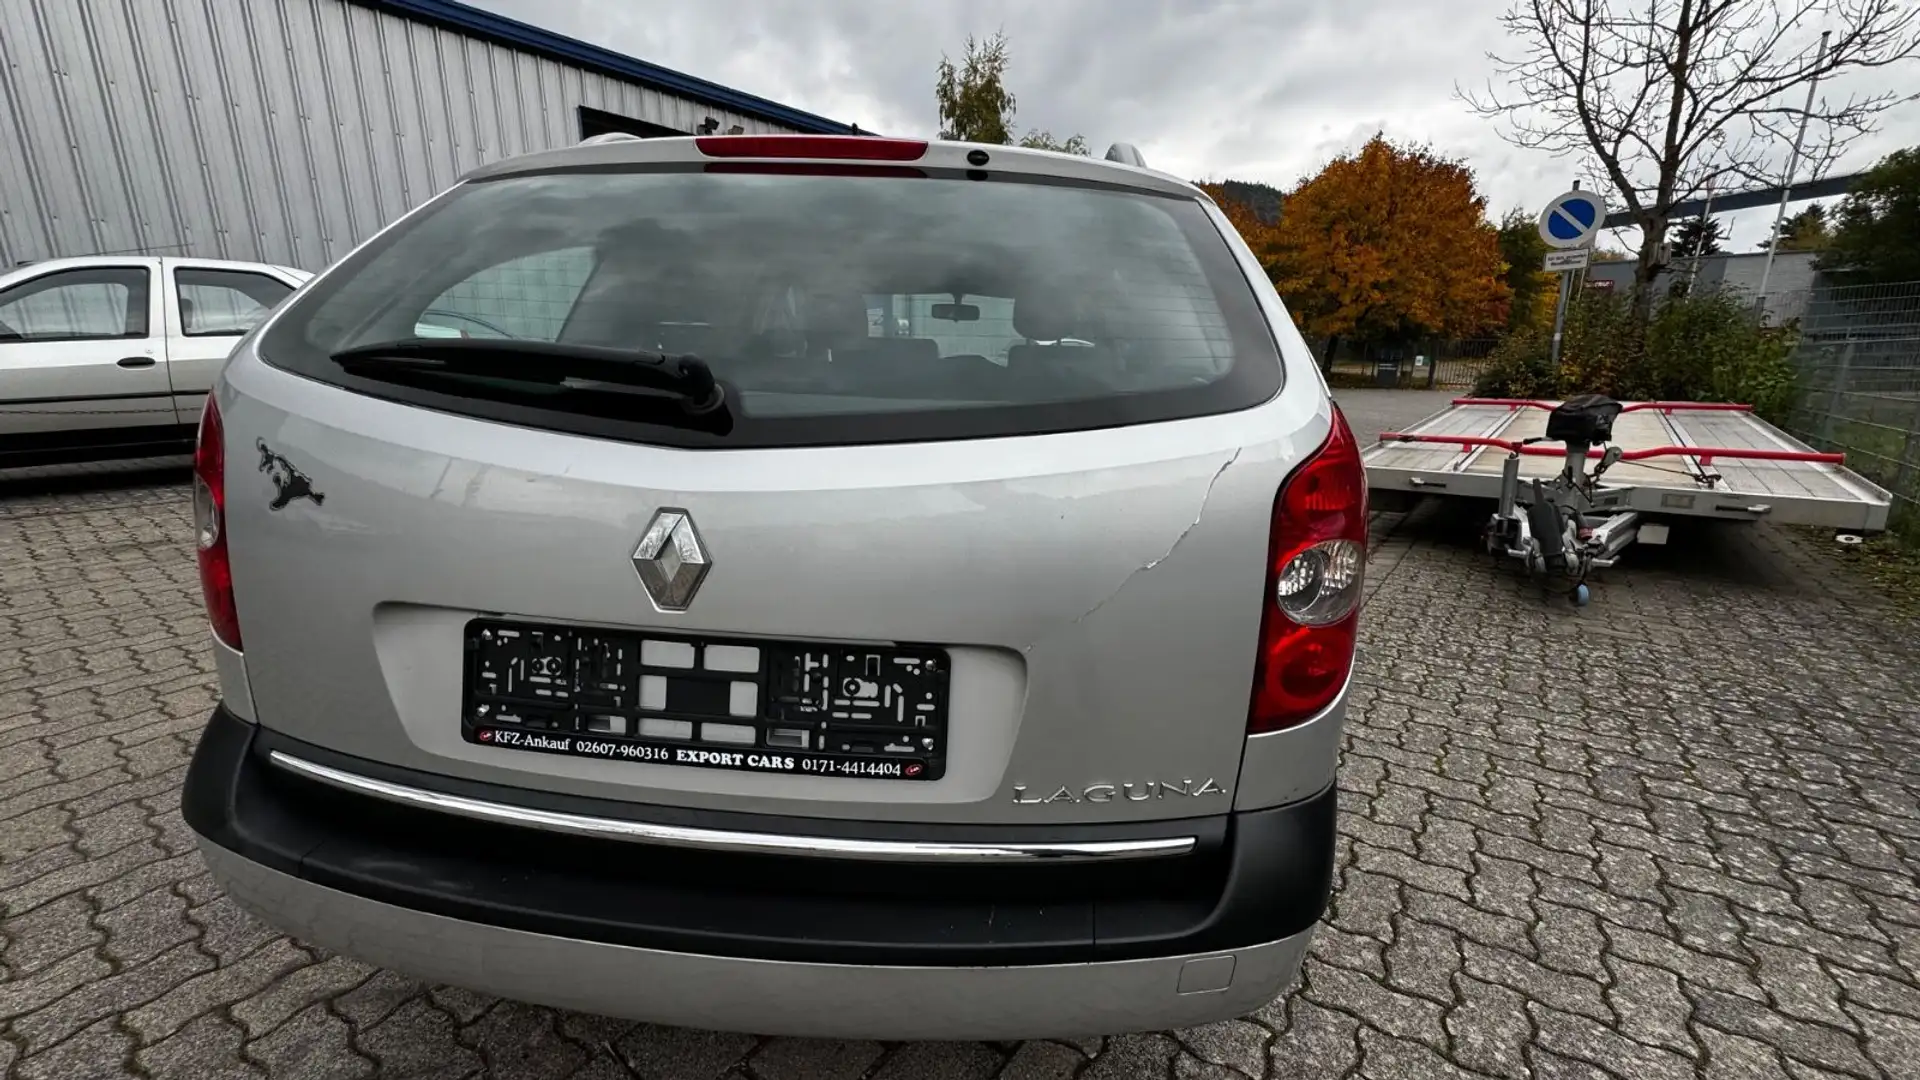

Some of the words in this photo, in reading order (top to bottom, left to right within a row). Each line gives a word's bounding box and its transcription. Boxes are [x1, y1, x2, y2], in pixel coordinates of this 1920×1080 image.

[494, 730, 571, 751] KFZ-Ankauf
[576, 741, 669, 760] 02607-960316
[676, 749, 744, 766] EXPORT
[747, 754, 795, 770] CARS
[802, 757, 901, 777] 0171-4414404
[1013, 778, 1227, 804] LAGUNA
